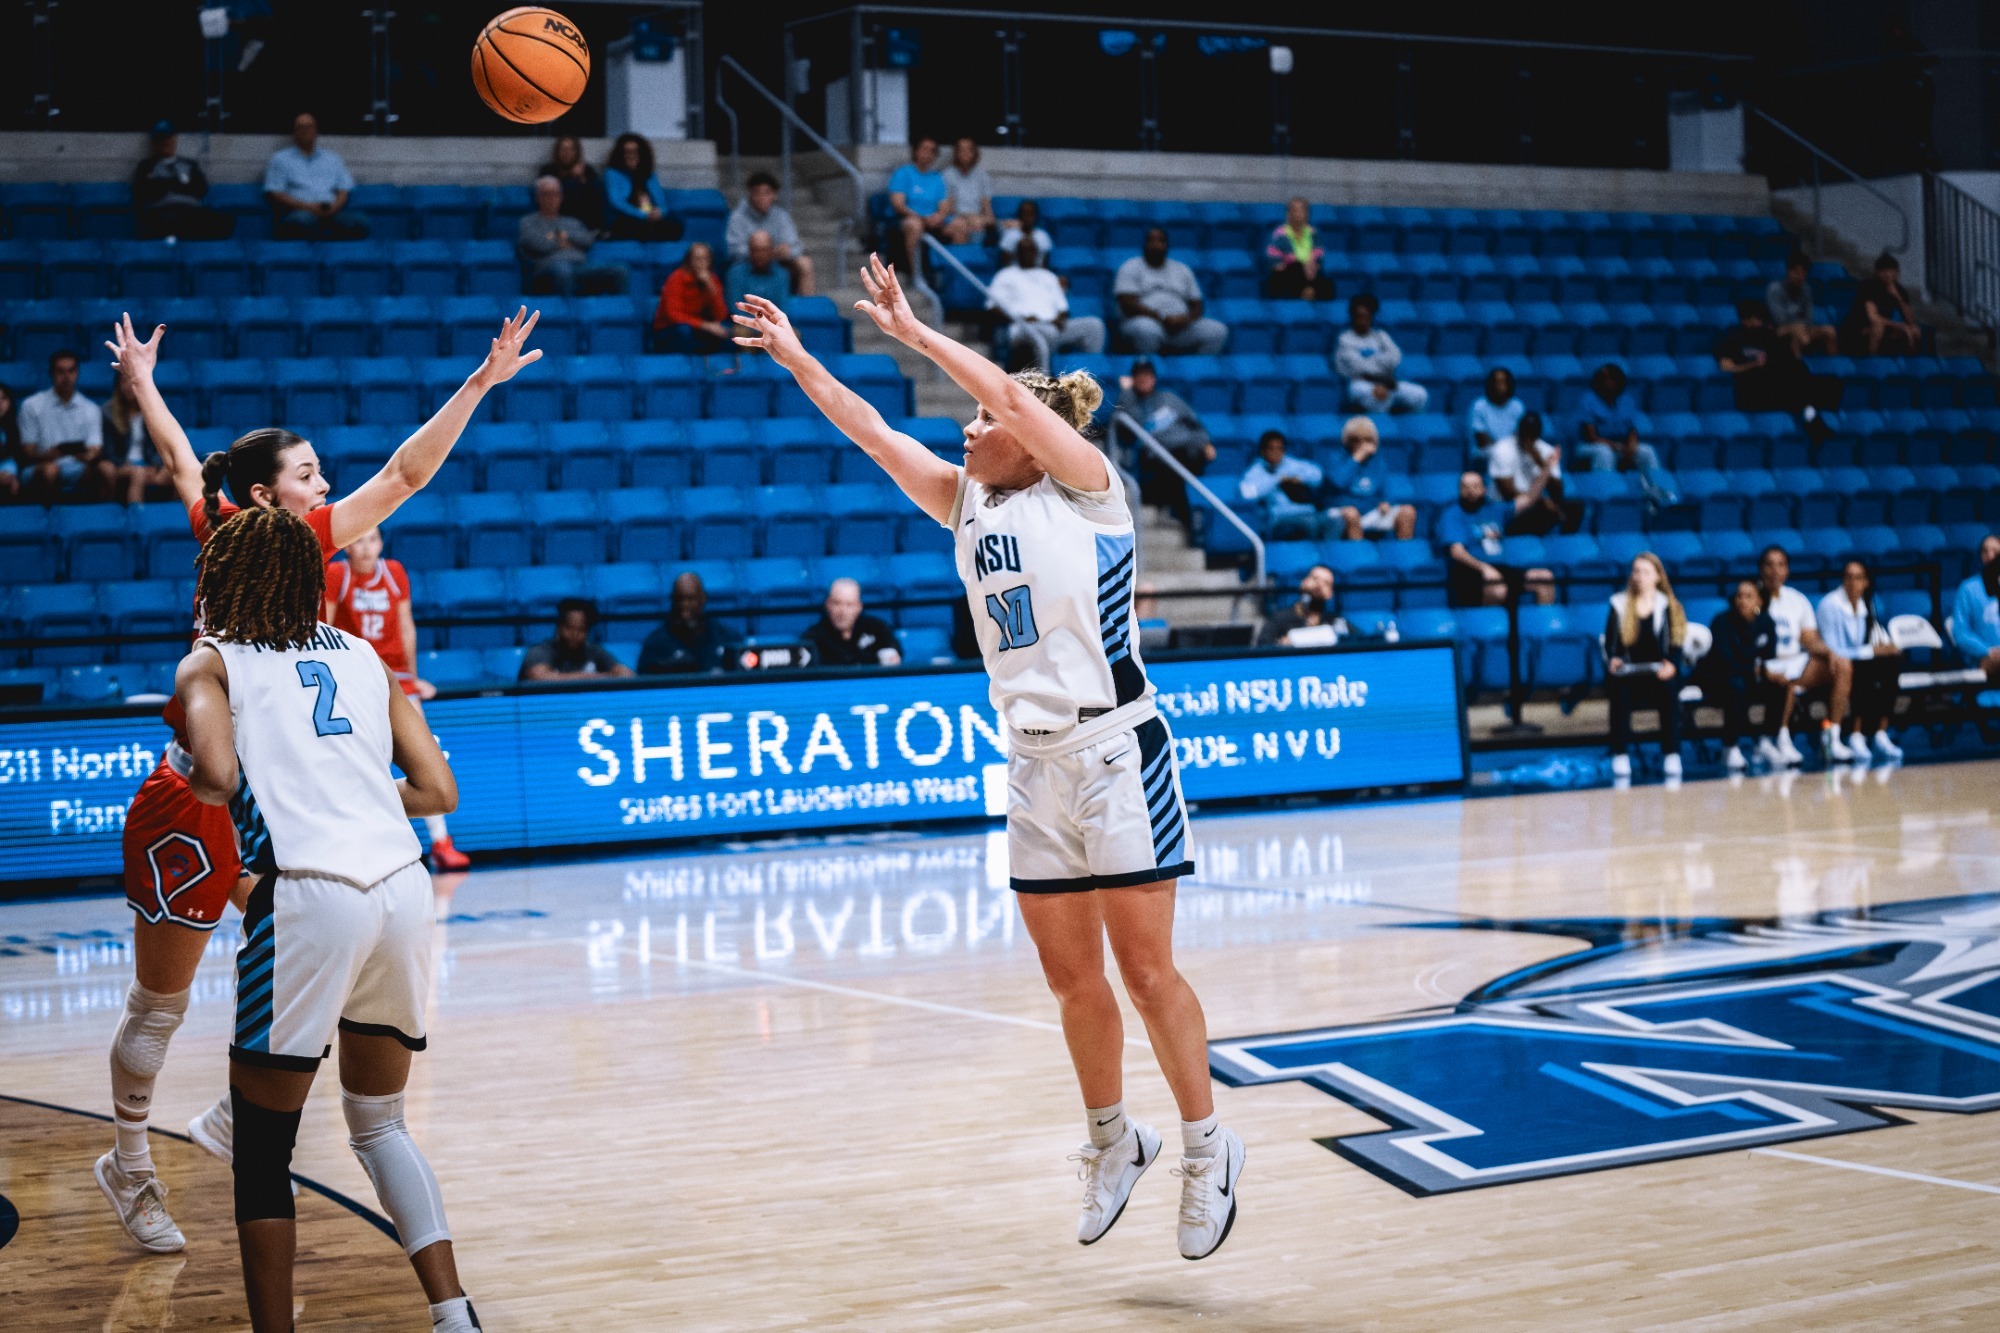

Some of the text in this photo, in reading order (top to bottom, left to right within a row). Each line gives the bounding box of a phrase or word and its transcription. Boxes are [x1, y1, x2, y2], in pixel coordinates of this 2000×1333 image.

[544, 17, 588, 57] NCAA
[975, 534, 1022, 582] NSU
[985, 584, 1039, 653] 10
[295, 660, 352, 737] 2
[1225, 678, 1292, 715] NSU
[1298, 675, 1368, 709] Rate
[52, 742, 156, 781] North
[577, 701, 1008, 787] SHERATON
